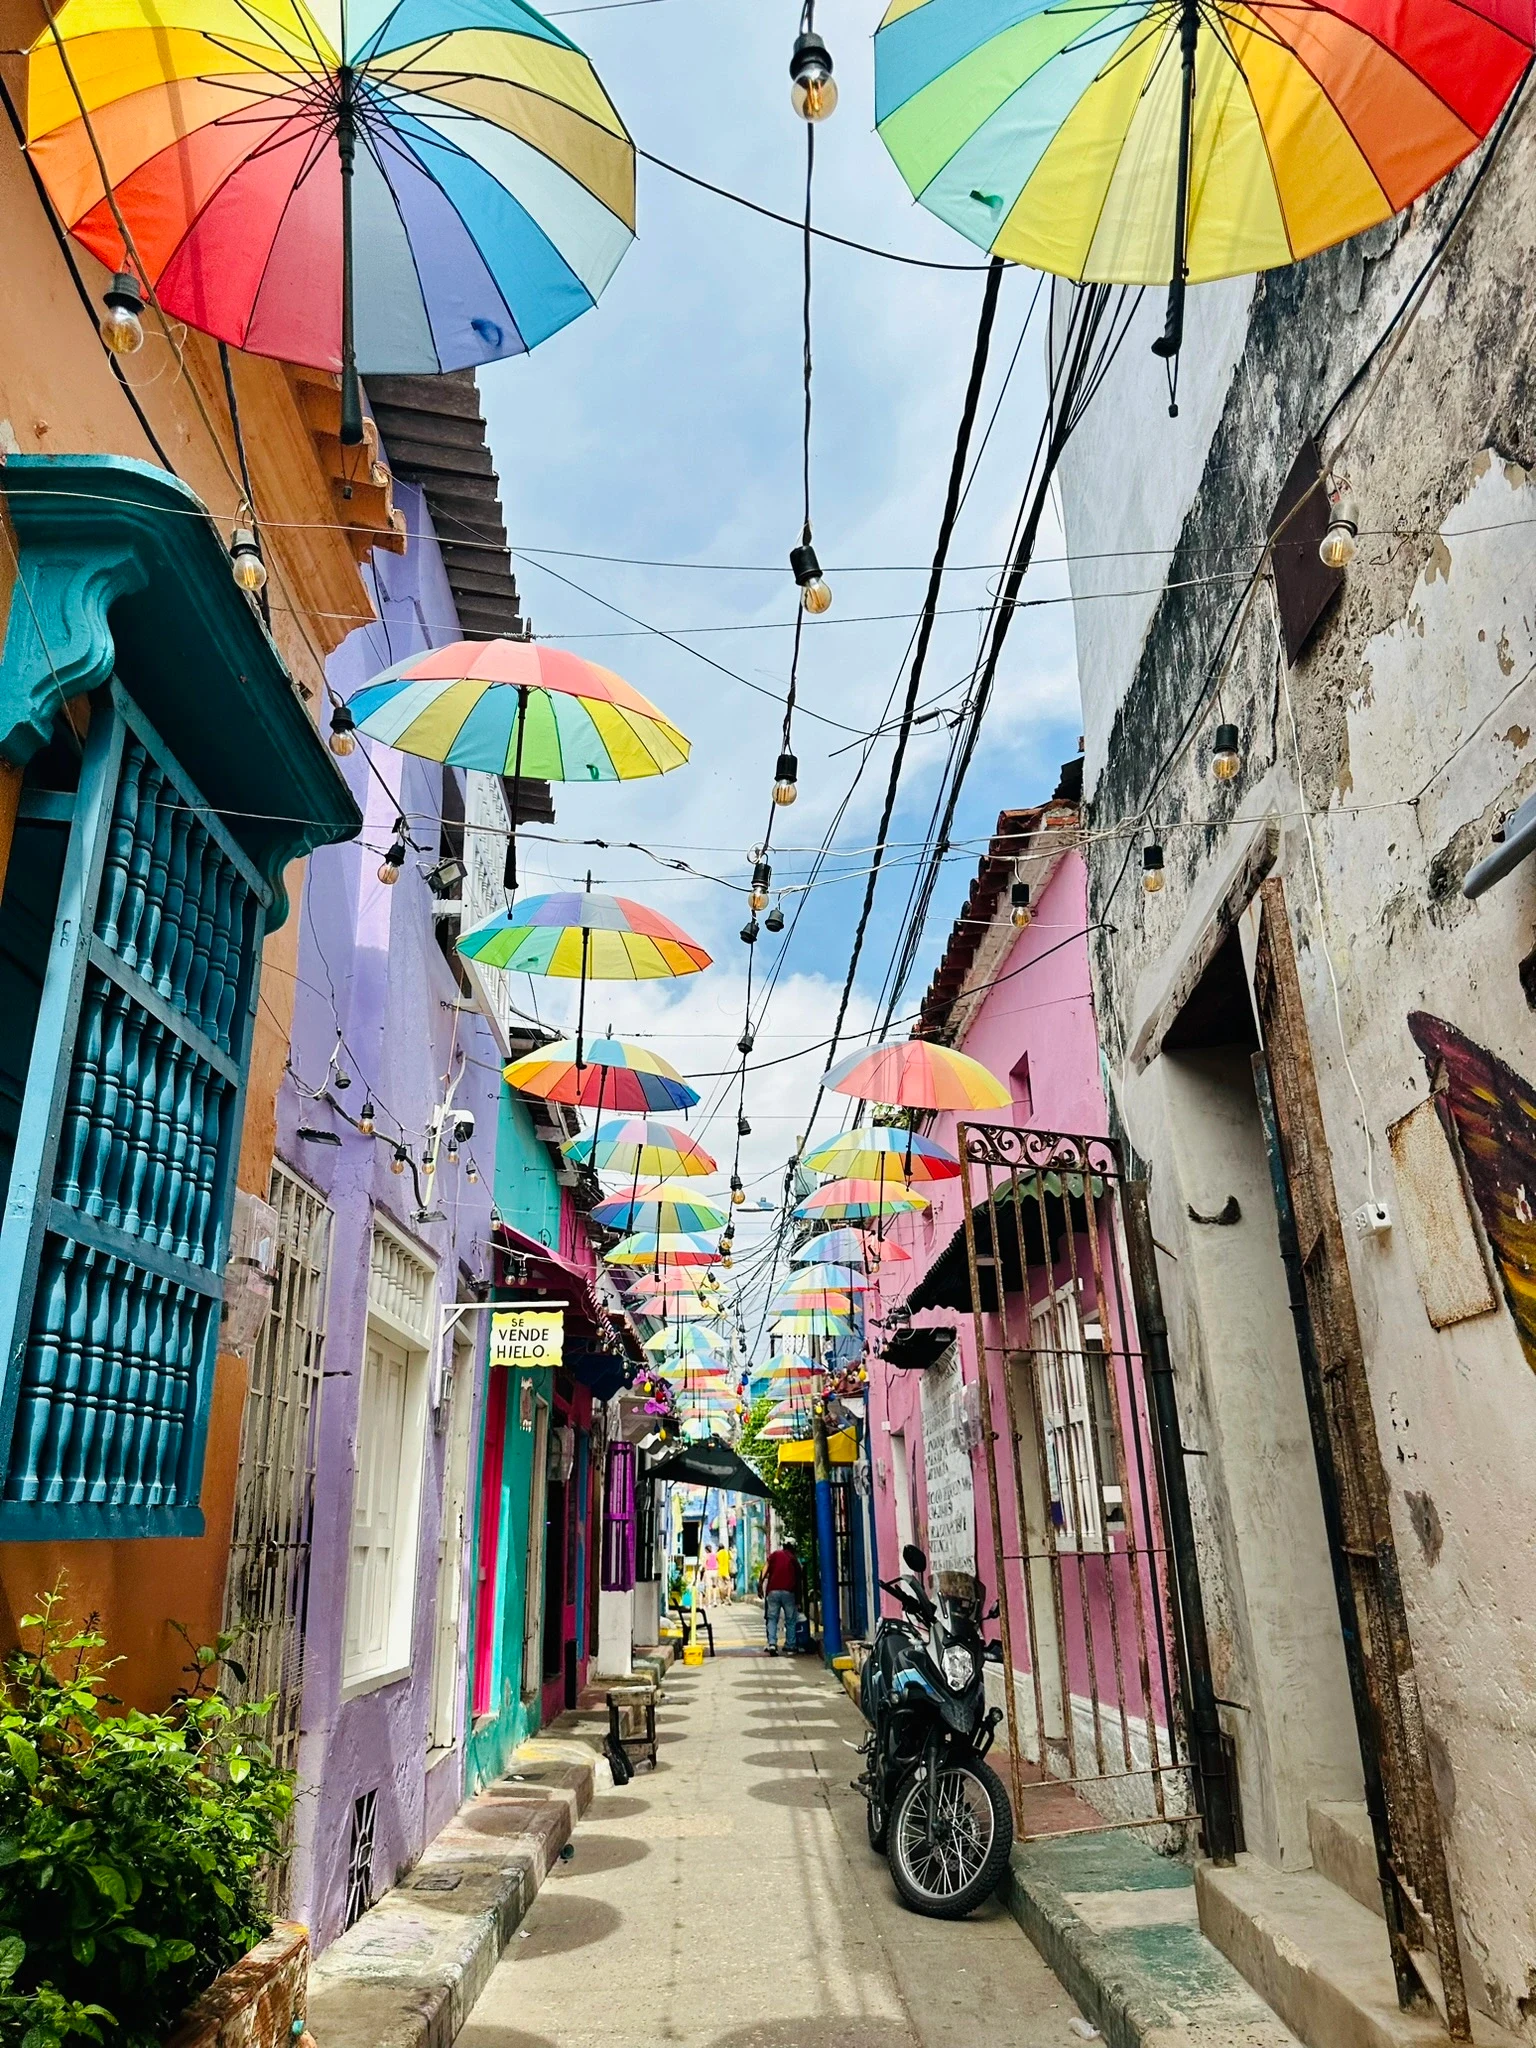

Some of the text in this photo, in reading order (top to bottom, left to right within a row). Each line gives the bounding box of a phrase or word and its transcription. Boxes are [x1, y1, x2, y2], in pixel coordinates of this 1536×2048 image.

[511, 1318, 524, 1327] SE
[499, 1328, 549, 1341] VENDE
[497, 1345, 550, 1358] HIELO.
